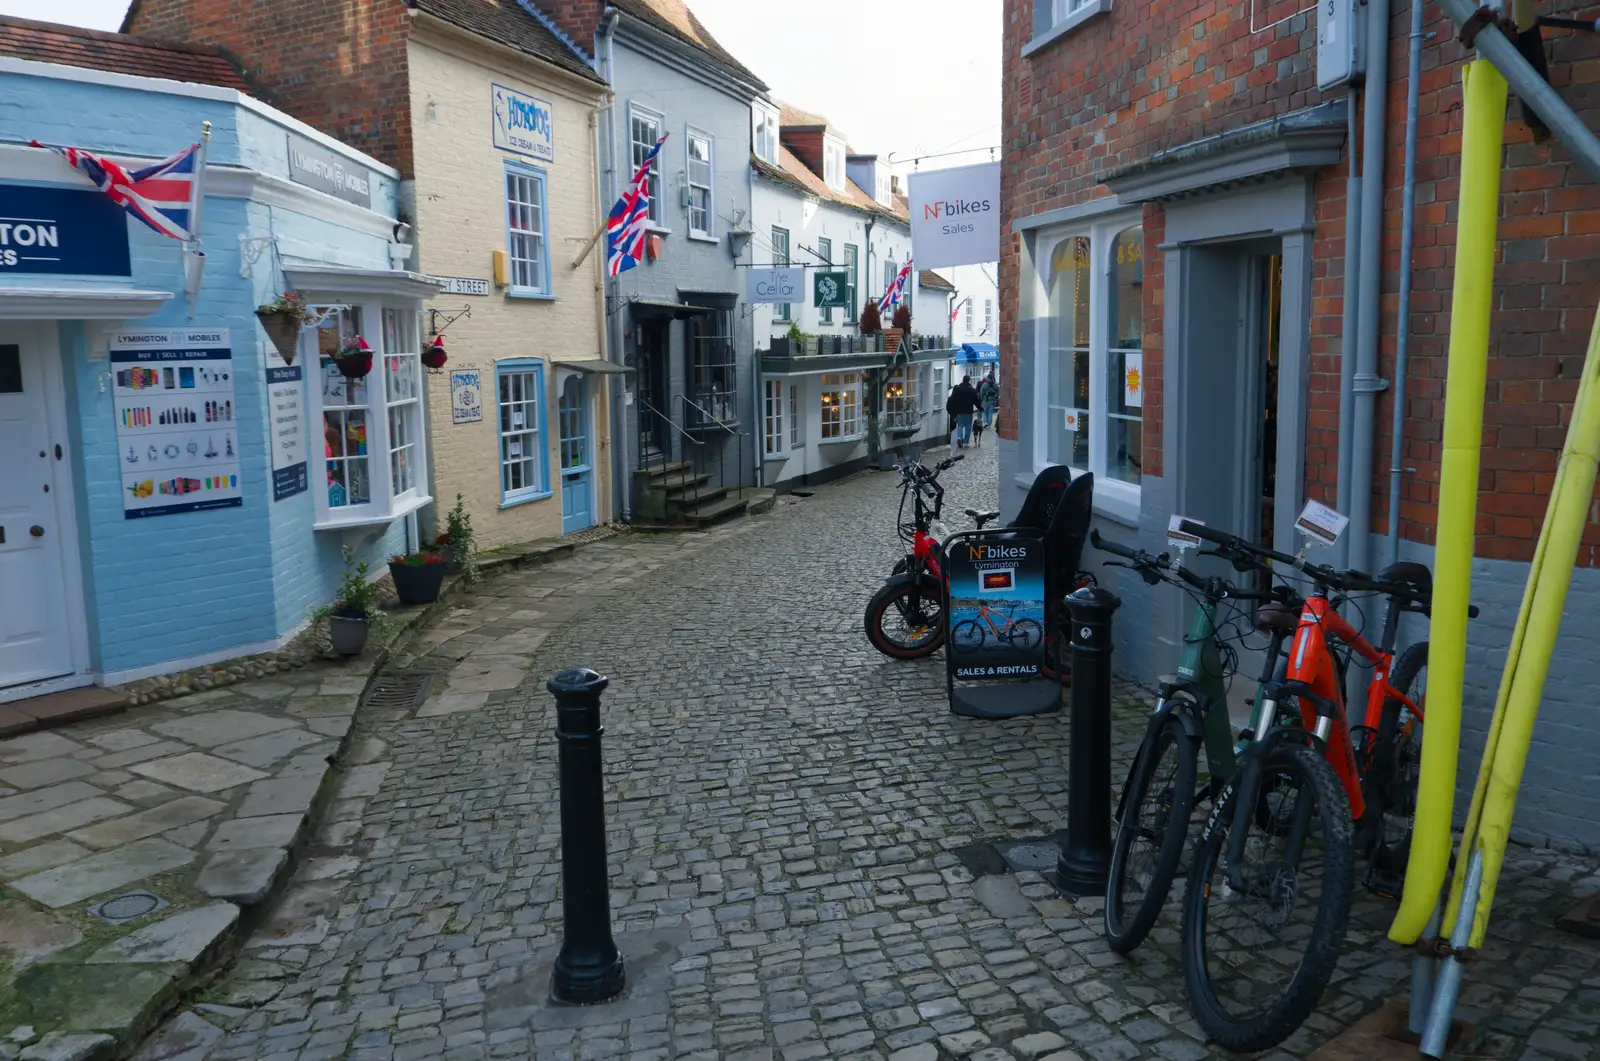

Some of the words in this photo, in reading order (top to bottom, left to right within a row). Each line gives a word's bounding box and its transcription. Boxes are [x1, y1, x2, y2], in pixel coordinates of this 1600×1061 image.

[1327, 0, 1335, 16] 3
[924, 199, 991, 220] NFbikes
[942, 223, 974, 235] Sales
[769, 271, 788, 282] The
[456, 280, 487, 293] STREET
[756, 278, 795, 295] Cellar
[118, 335, 168, 343] LYMINGTON
[187, 334, 221, 342] MOBILES
[162, 351, 178, 359] SELL
[969, 545, 1027, 560] NFbikes
[974, 561, 1020, 570] Lymington
[957, 667, 986, 676] SALES
[987, 666, 996, 675] &
[996, 665, 1038, 675] RENTALS
[1202, 784, 1233, 841] MAXXIS
